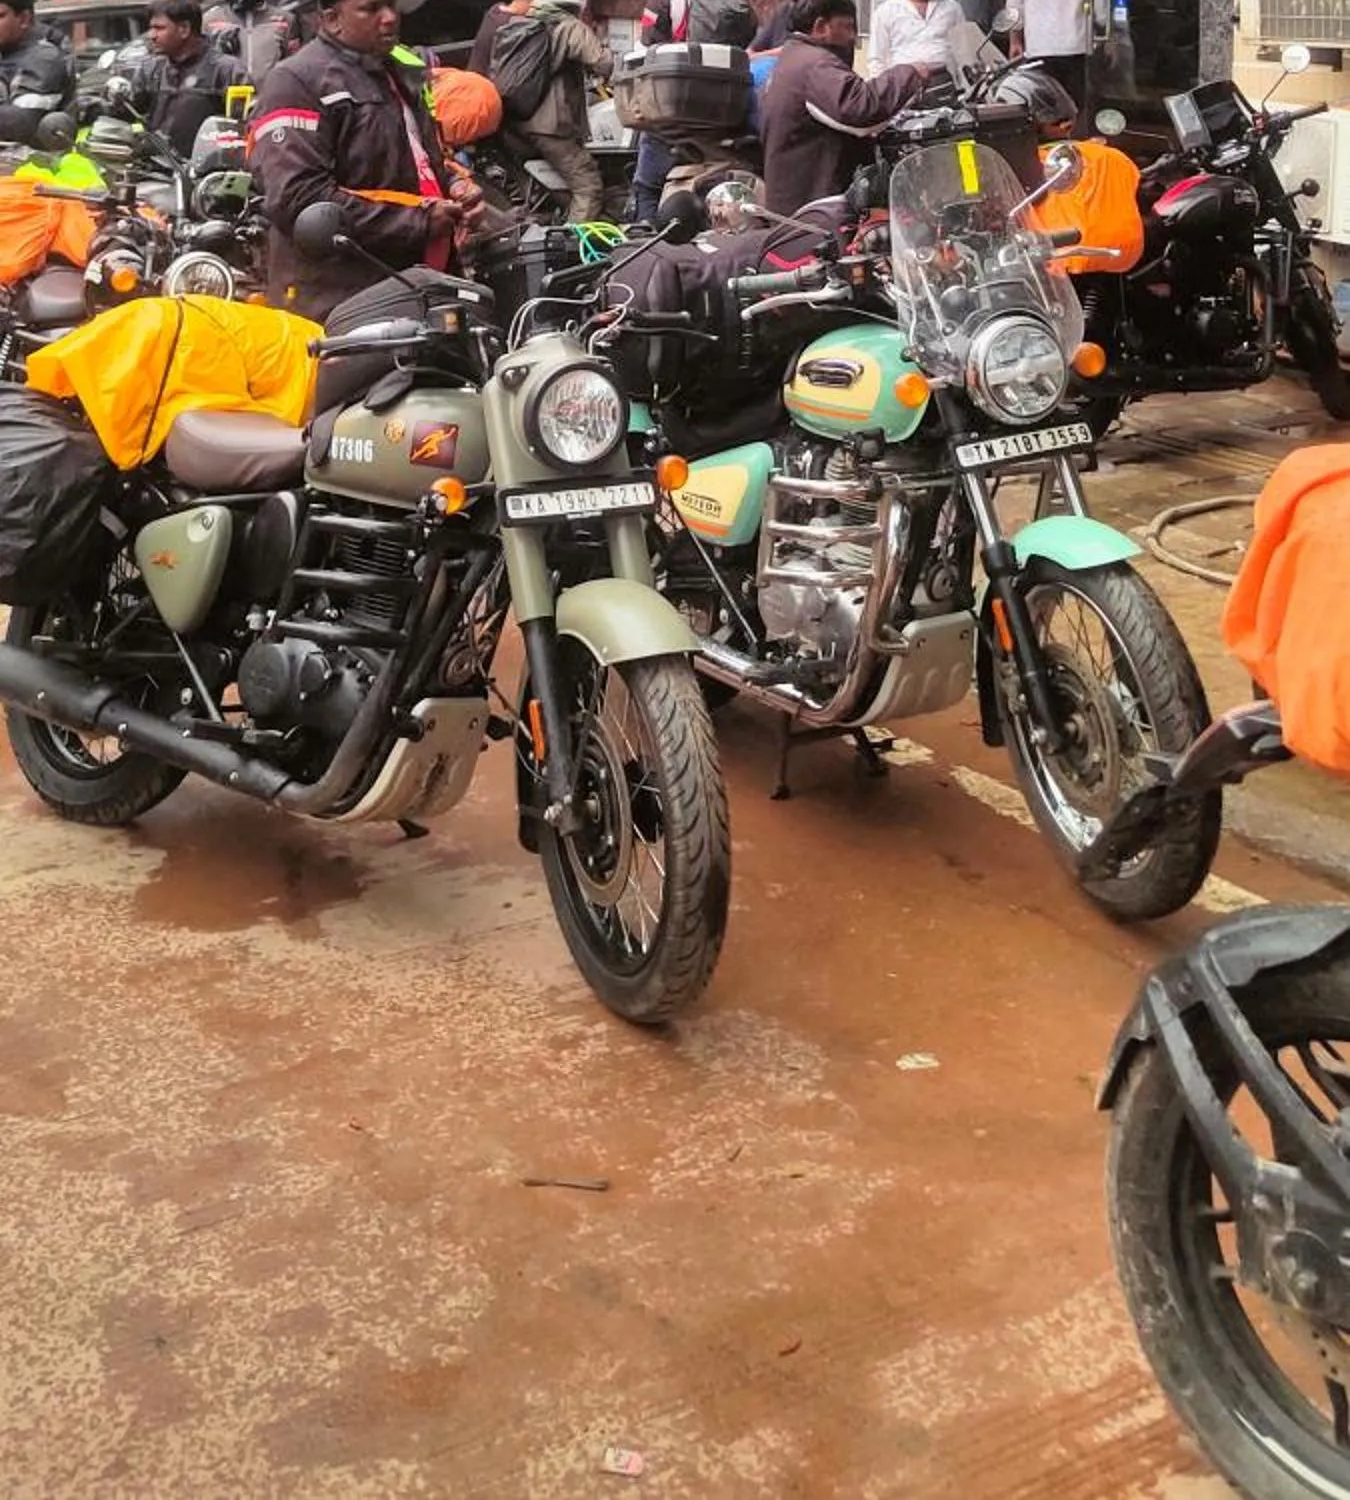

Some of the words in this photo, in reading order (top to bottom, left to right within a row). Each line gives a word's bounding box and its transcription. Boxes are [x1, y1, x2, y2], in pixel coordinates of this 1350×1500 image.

[1046, 425, 1090, 447] 3559
[524, 495, 547, 514] KA
[607, 484, 652, 506] 2211
